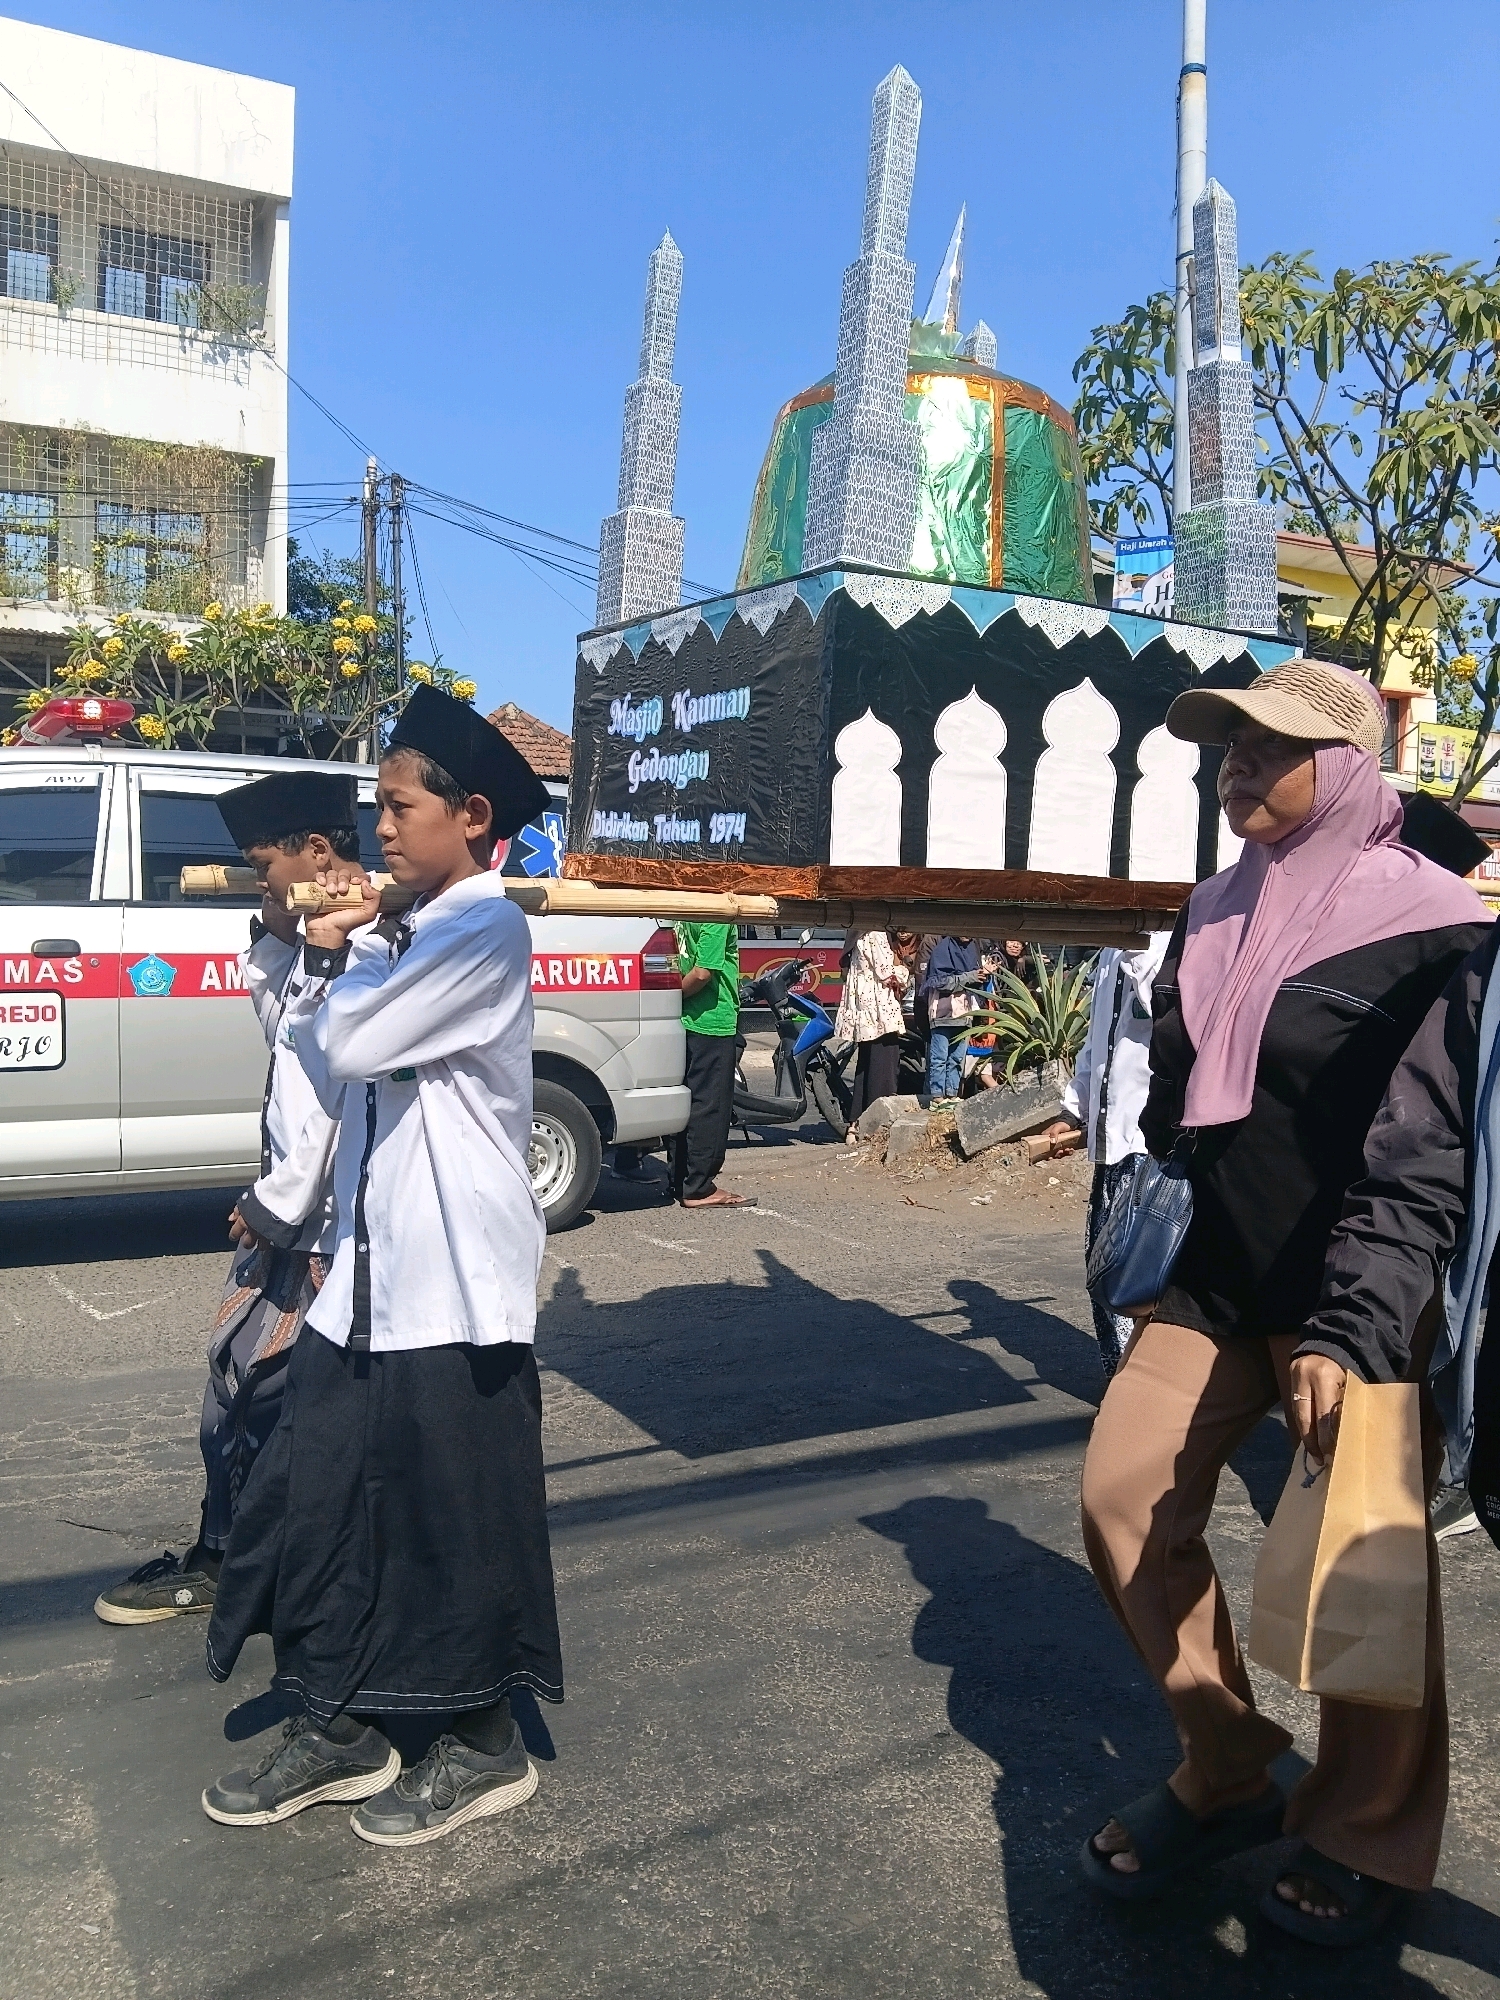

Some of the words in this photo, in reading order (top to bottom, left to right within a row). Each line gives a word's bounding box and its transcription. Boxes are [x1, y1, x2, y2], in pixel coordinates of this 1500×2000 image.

[1120, 542, 1136, 551] Haji
[1139, 539, 1167, 548] Umrah
[608, 692, 664, 742] Masjid
[672, 686, 751, 732] Kauman
[628, 747, 710, 794] Gedongan
[593, 810, 649, 842] Didirikan
[653, 812, 701, 843] Tahun
[709, 812, 747, 844] 1974
[4, 958, 84, 984] MAS
[530, 958, 634, 986] ARURAT
